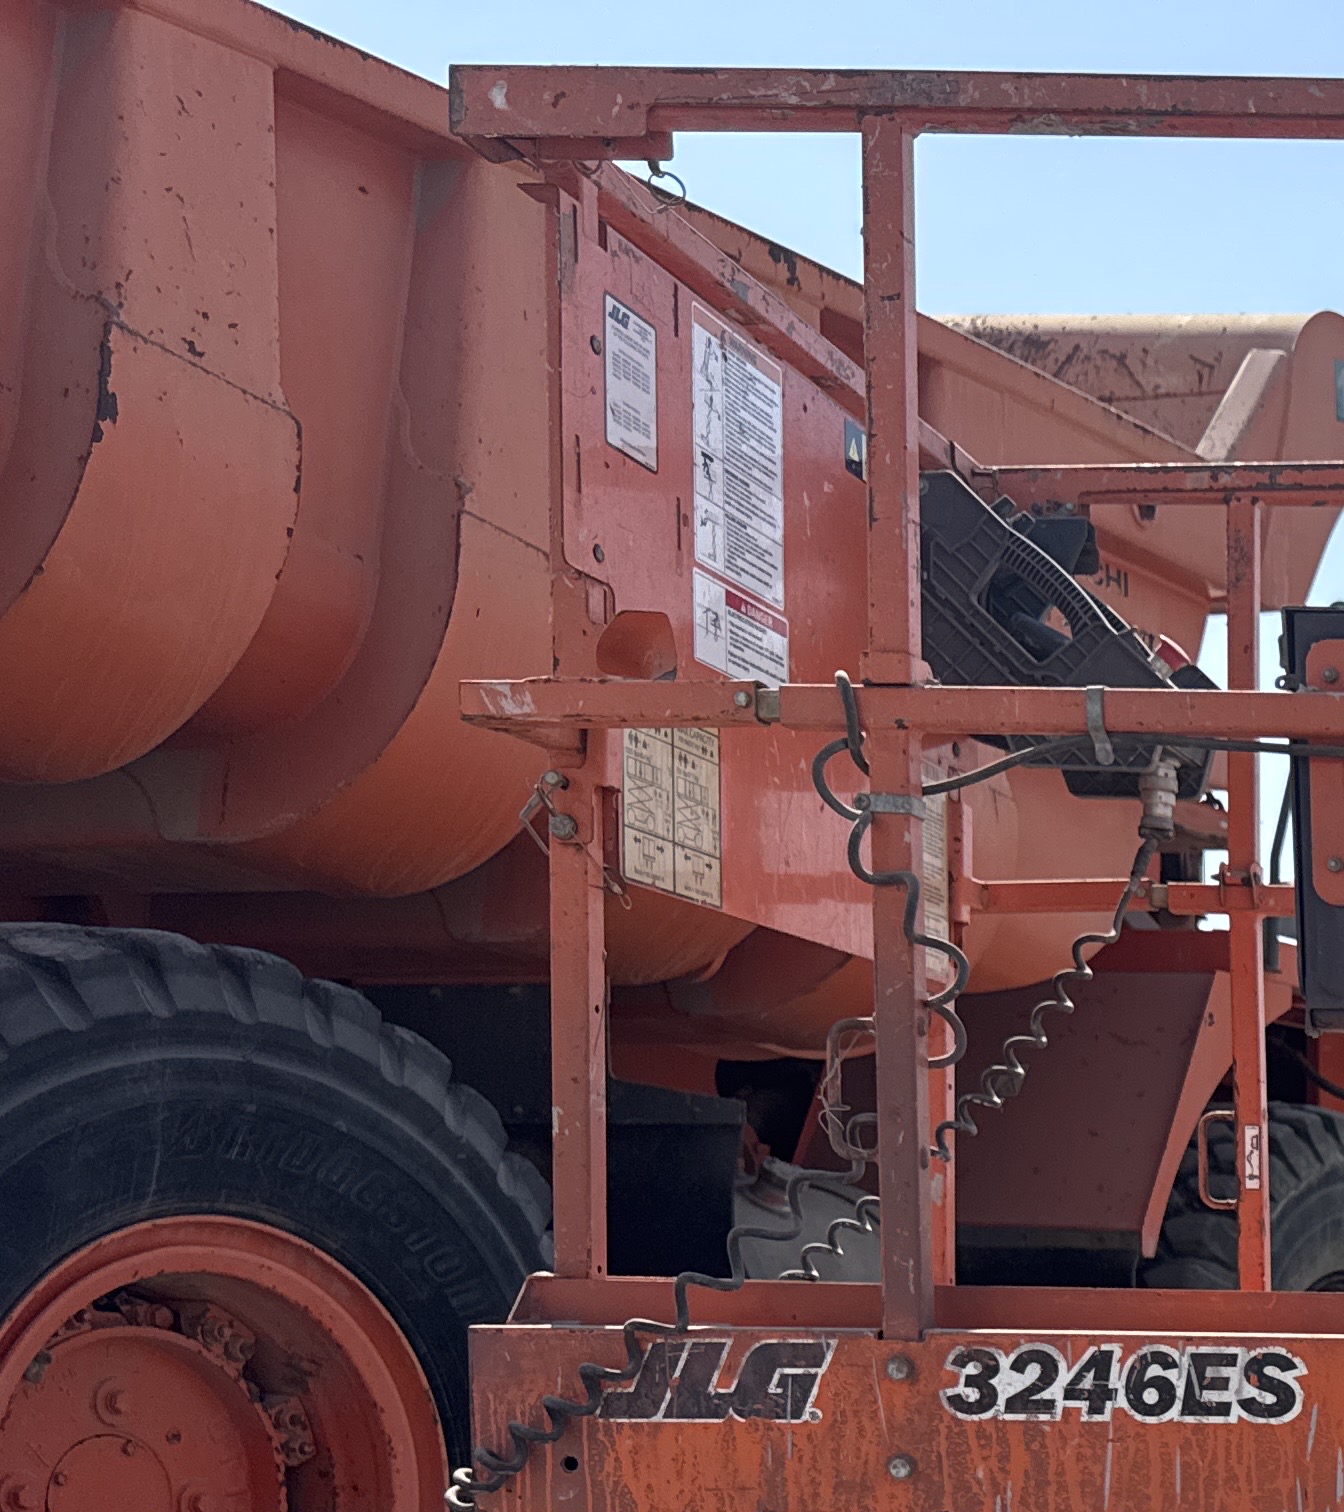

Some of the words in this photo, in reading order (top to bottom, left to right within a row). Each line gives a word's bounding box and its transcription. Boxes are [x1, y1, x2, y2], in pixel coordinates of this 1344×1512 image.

[608, 304, 630, 329] JLG
[599, 1338, 836, 1422] JLG
[941, 1341, 1309, 1425] 3246ES
